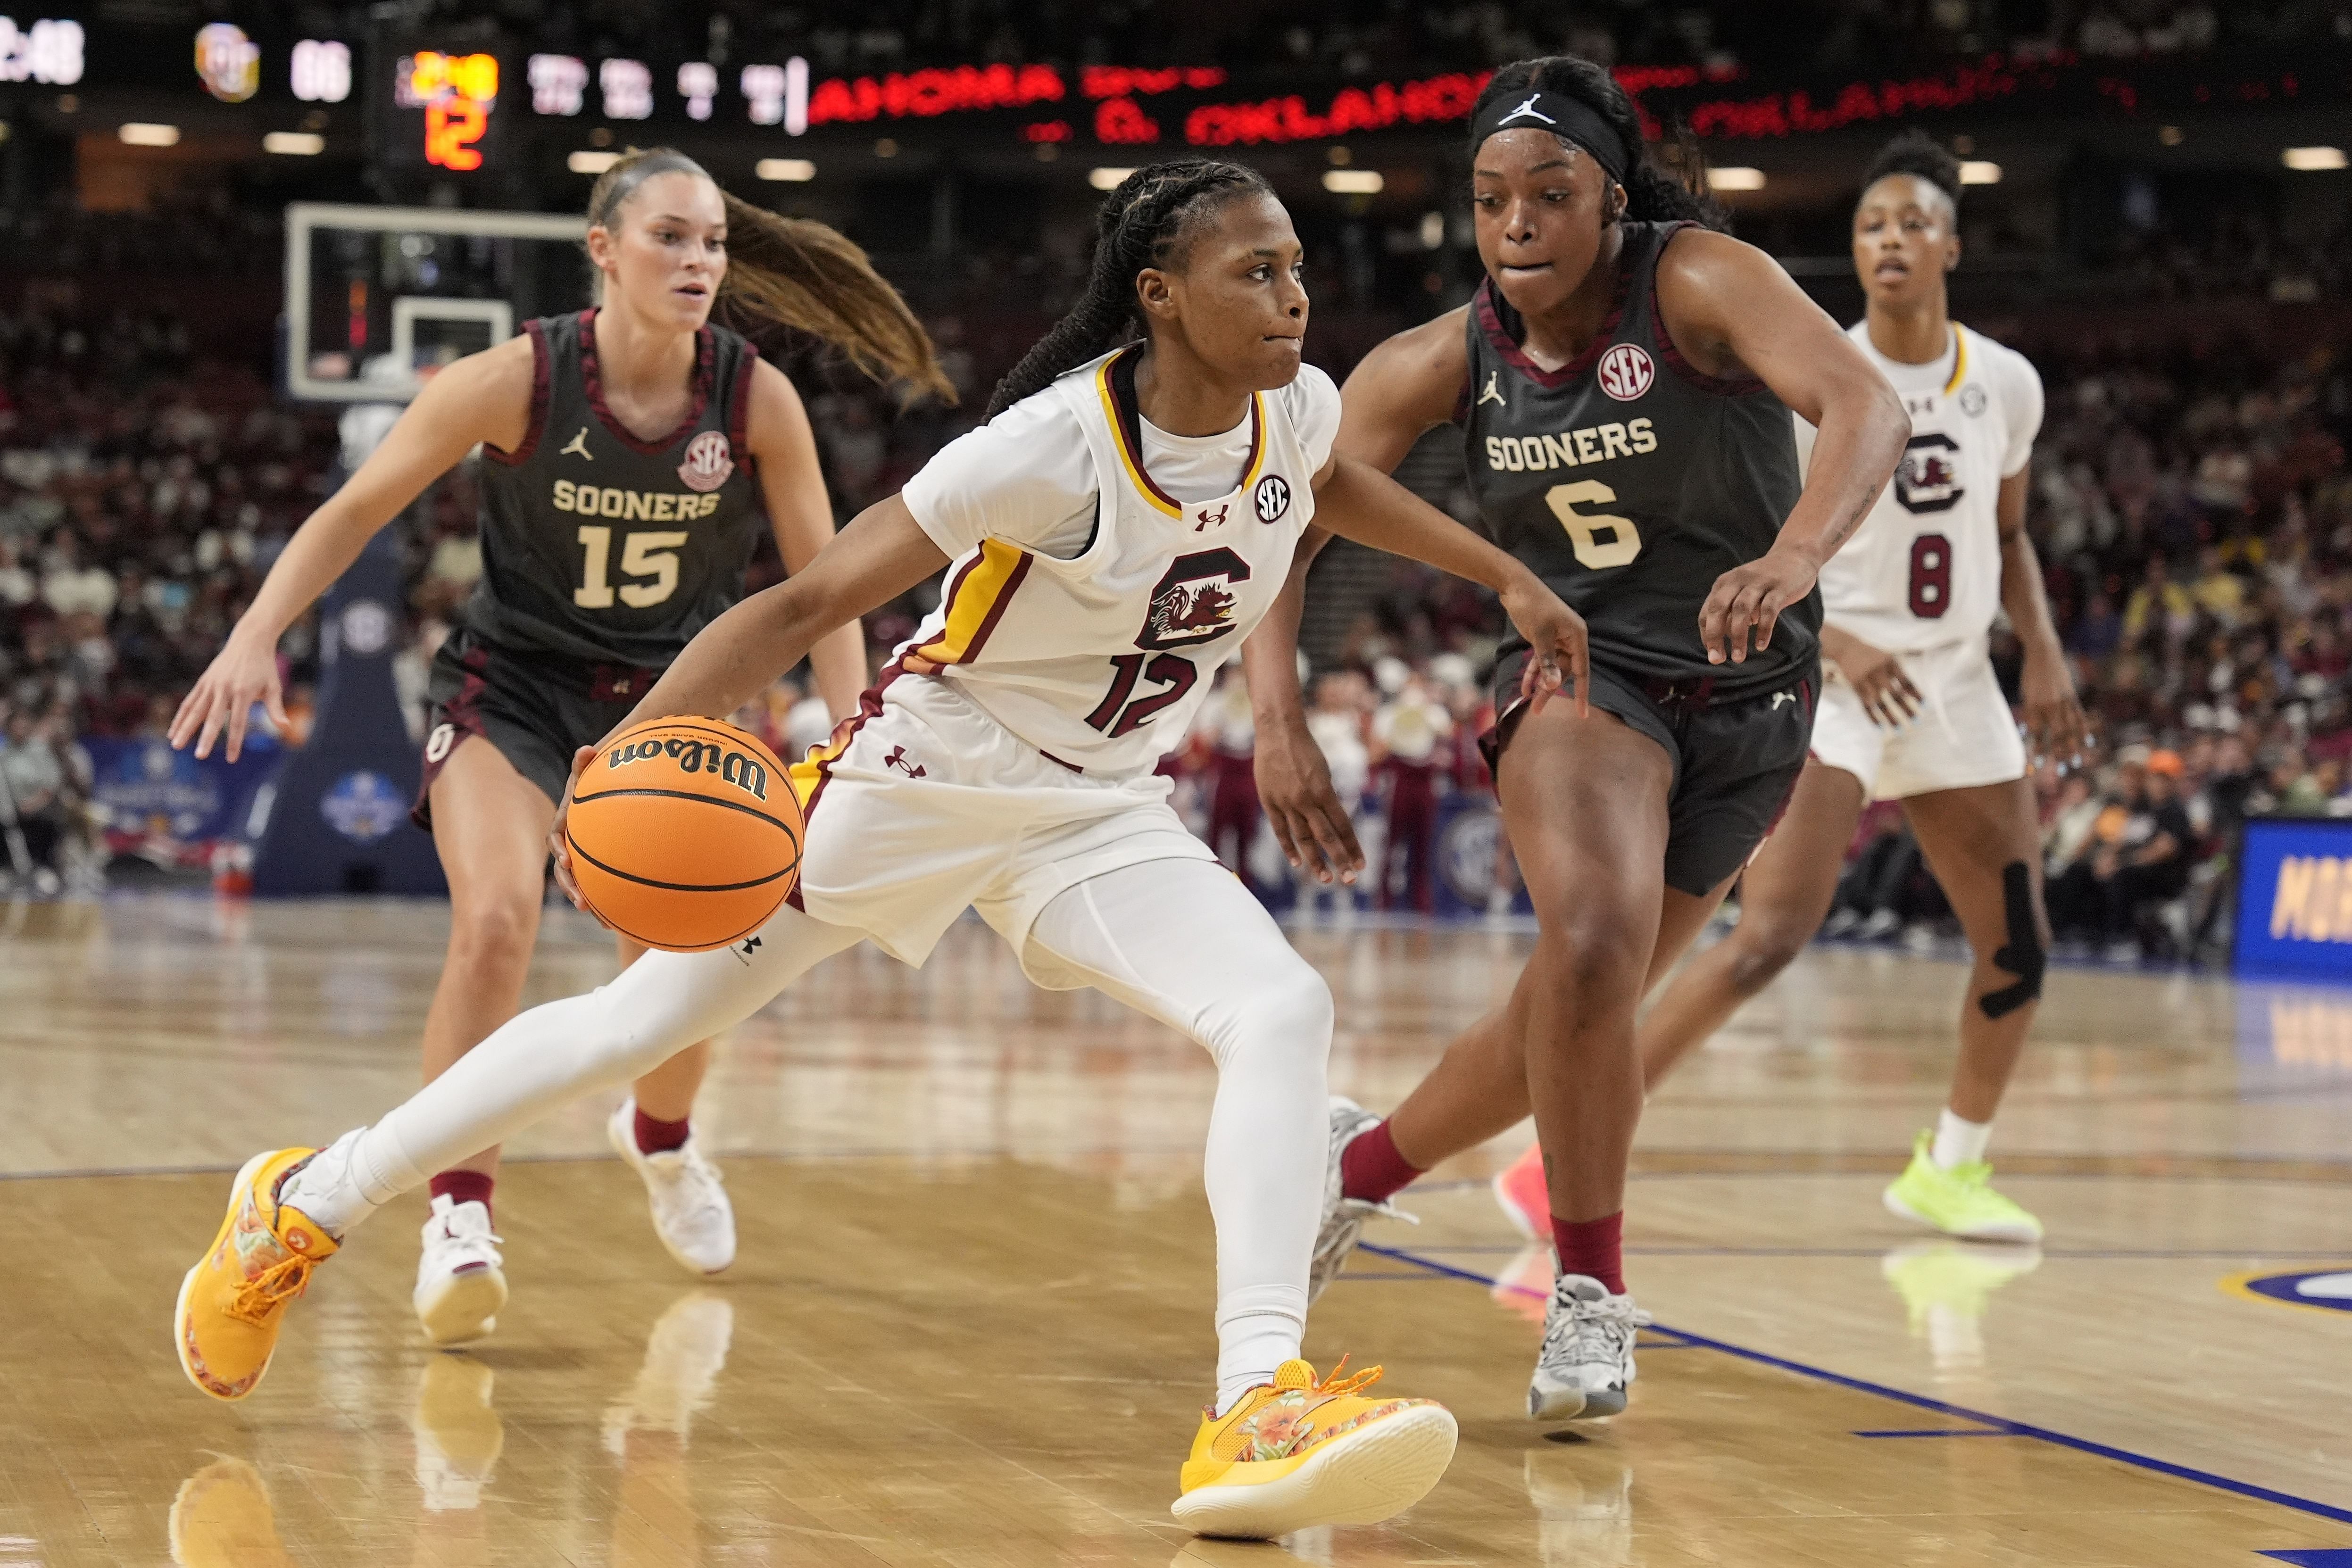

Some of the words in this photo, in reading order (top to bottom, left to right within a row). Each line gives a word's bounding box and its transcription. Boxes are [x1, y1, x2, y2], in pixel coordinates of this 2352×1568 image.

[1602, 347, 1650, 397] SEC
[1485, 416, 1658, 472] SOONERS
[552, 478, 722, 522] SOONERS
[1255, 478, 1290, 521] SEC
[1544, 479, 1643, 570] 6
[573, 525, 690, 609] 15
[1908, 534, 1953, 619] 8
[1083, 652, 1198, 739] 12
[607, 738, 768, 804] Wilson
